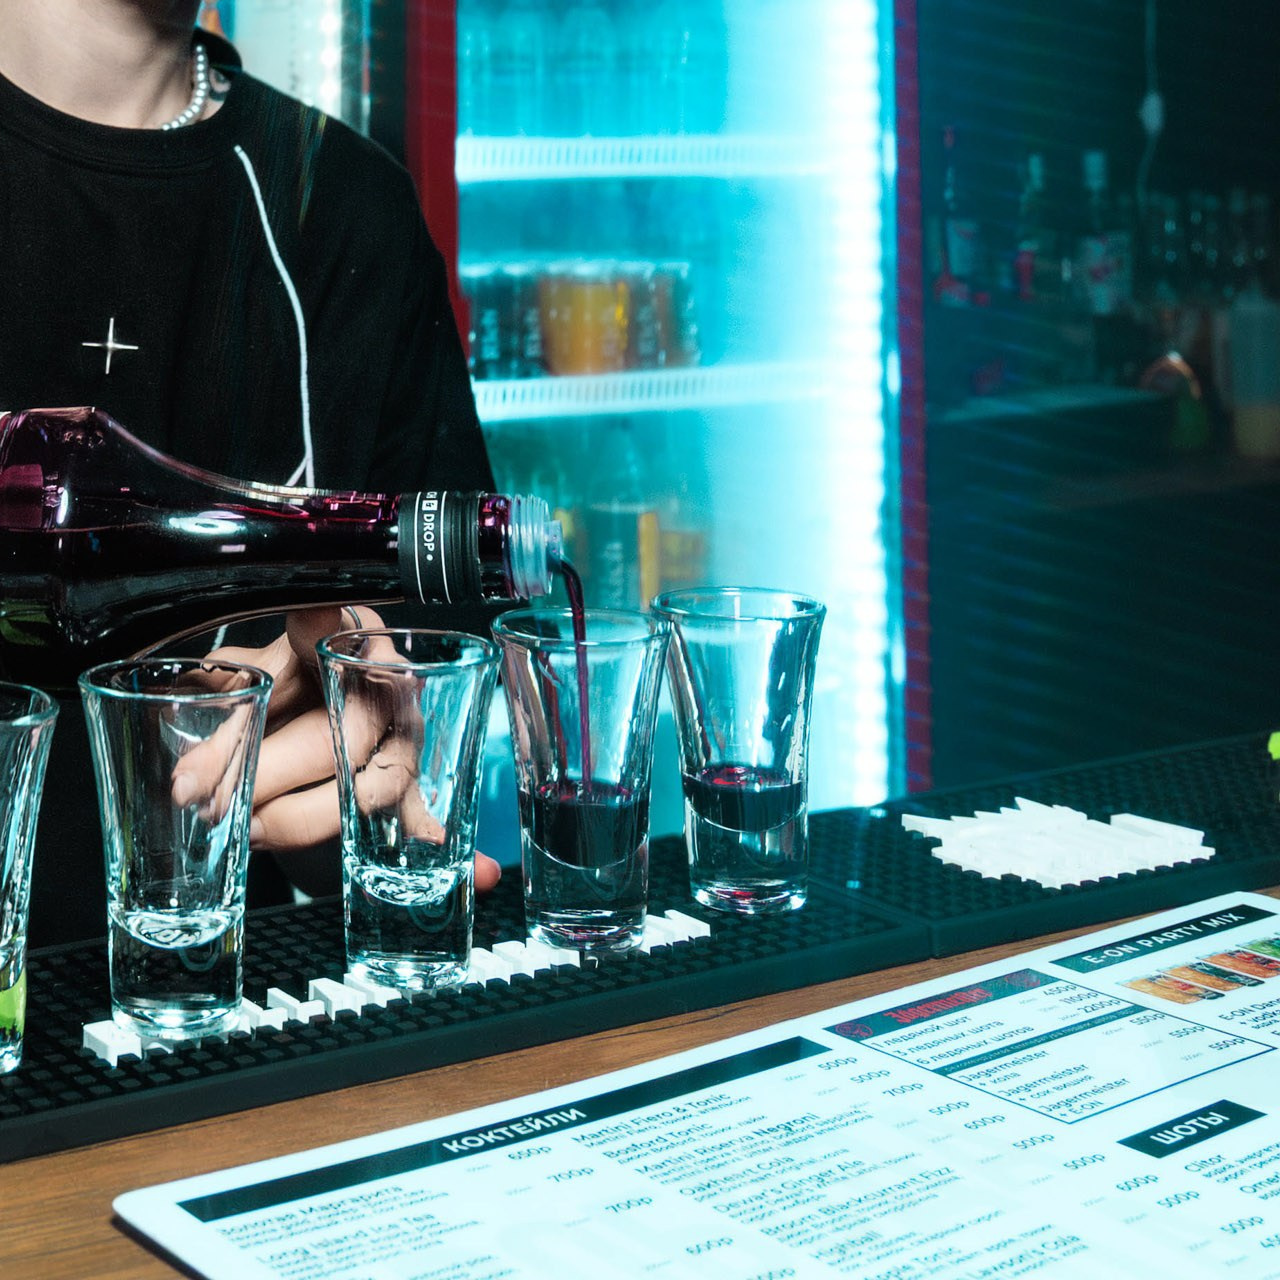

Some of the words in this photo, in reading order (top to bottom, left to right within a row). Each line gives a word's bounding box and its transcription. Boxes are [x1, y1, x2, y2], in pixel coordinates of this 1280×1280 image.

[423, 513, 435, 551] DROP
[1082, 940, 1139, 966] E-ON
[1141, 919, 1207, 950] PARTY
[1205, 908, 1247, 929] MIX
[441, 1106, 588, 1155] КОКТЕЙЛИ
[1149, 1109, 1231, 1146] ШОТЫ
